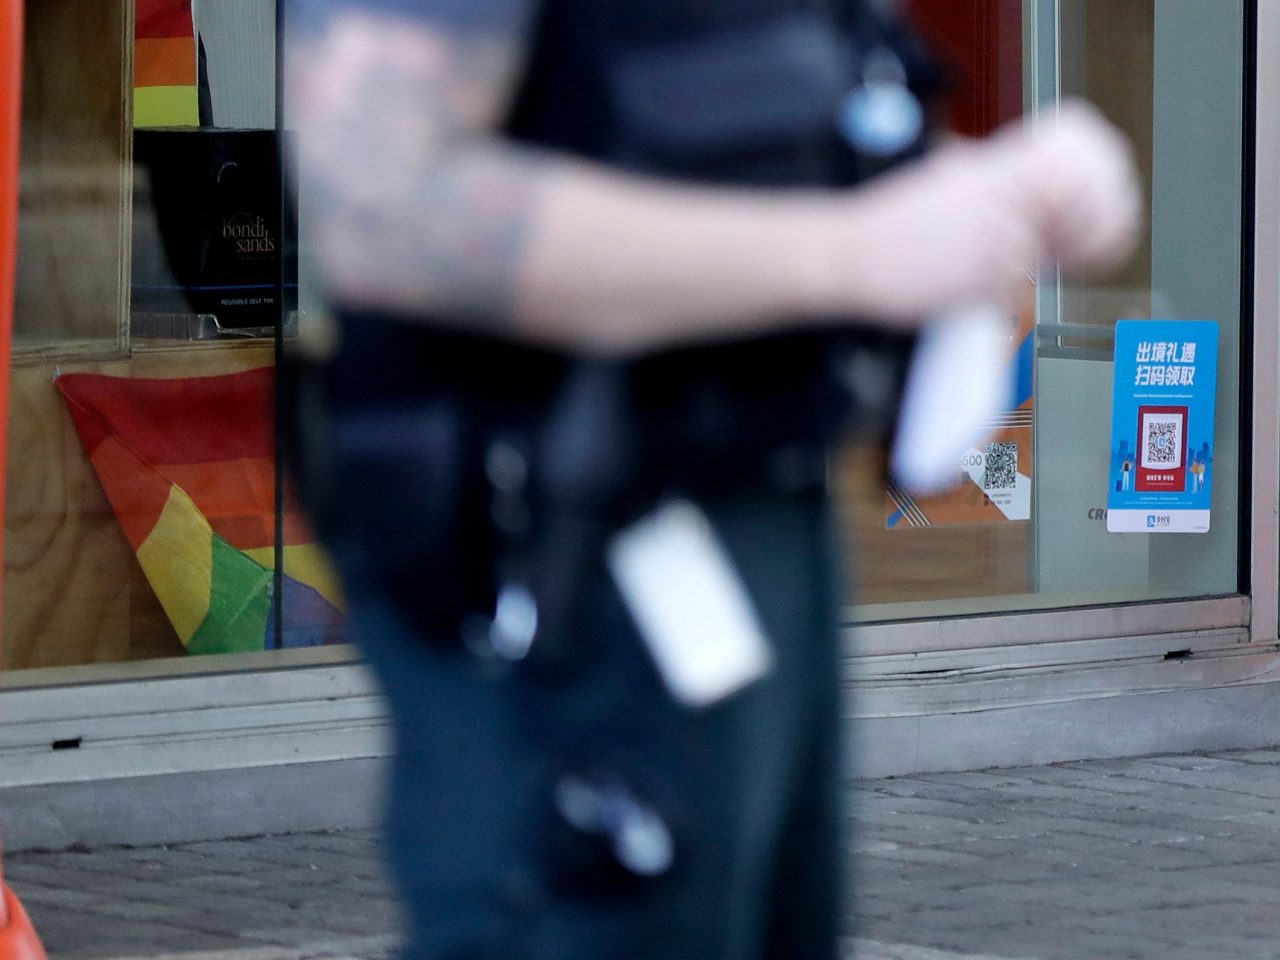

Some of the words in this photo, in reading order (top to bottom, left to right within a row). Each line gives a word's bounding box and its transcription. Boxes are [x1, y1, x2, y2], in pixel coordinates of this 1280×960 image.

[222, 216, 265, 238] bondi
[236, 229, 275, 253] sands
[1136, 341, 1196, 363] 出境礼遇
[1134, 364, 1196, 386] 扫码领取
